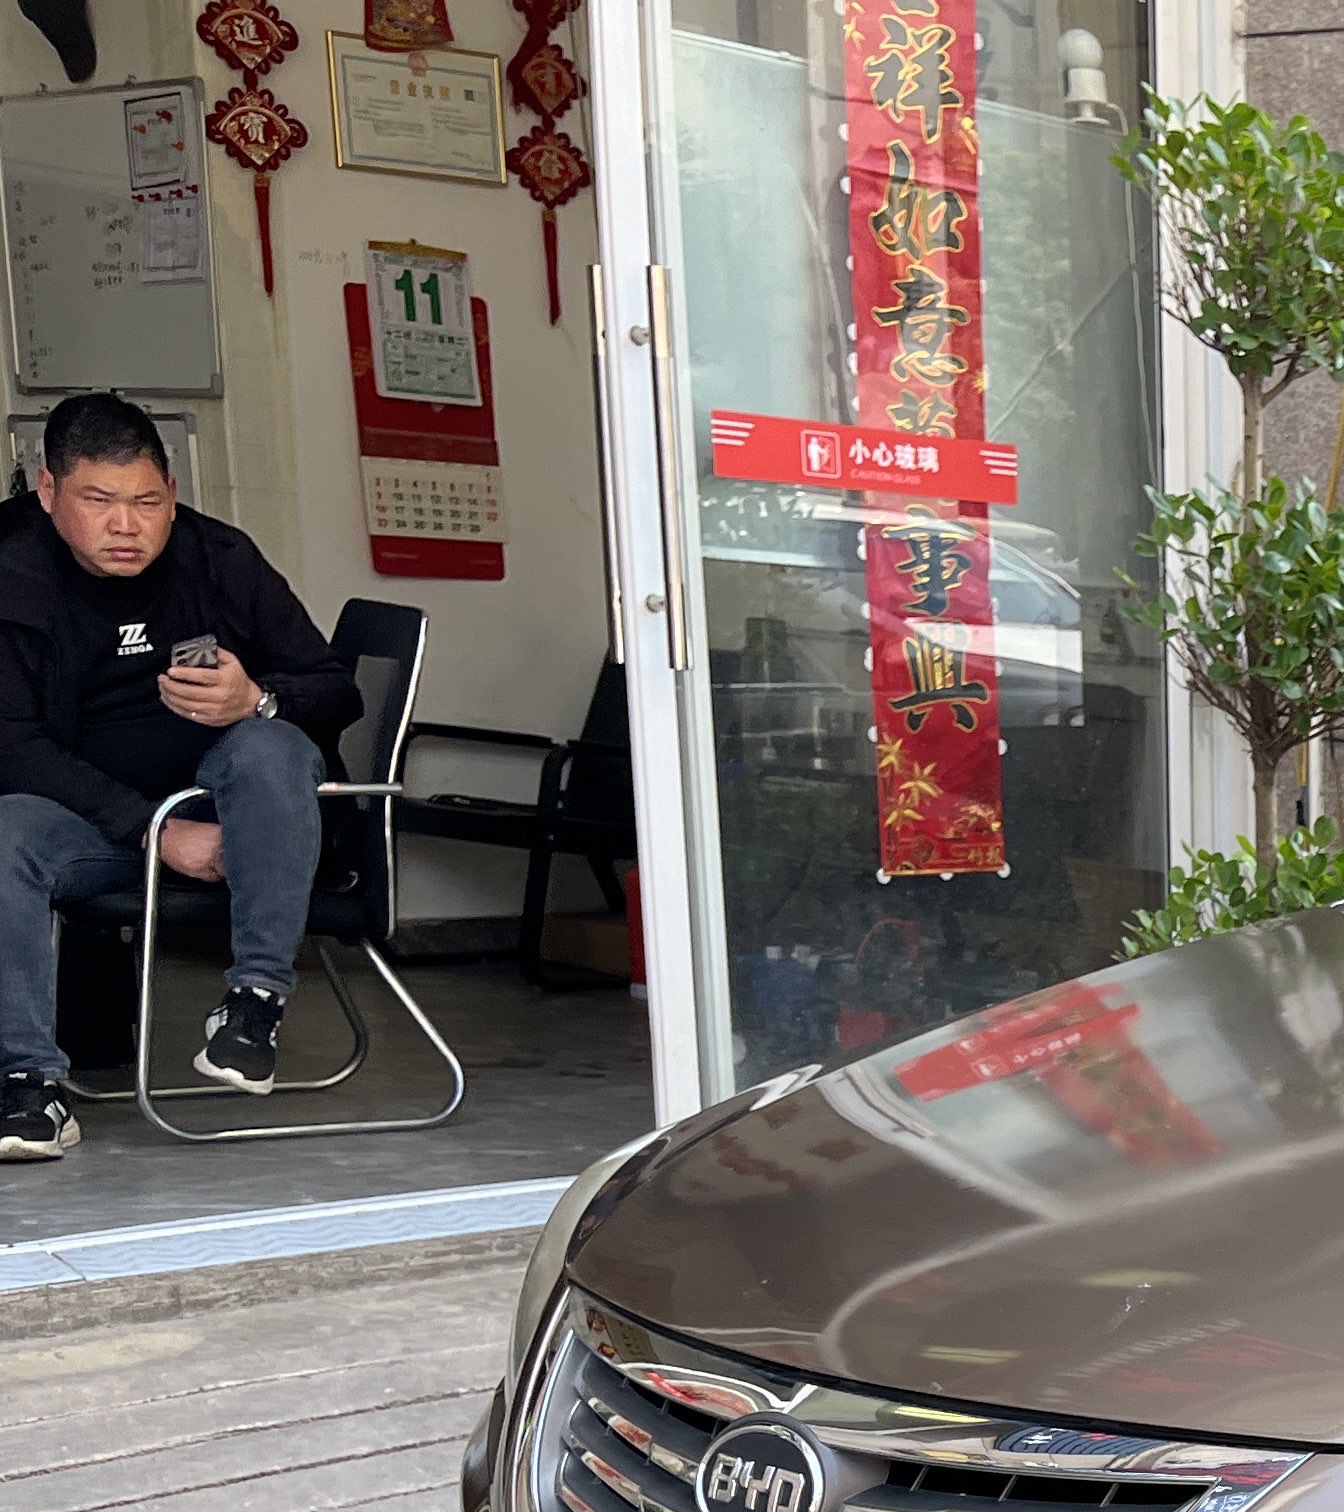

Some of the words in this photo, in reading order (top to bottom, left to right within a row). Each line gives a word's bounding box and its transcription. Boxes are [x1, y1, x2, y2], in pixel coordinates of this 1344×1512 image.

[394, 269, 443, 325] 11
[865, 0, 992, 735] 祥如意事興
[848, 438, 939, 473] 小心玻璃
